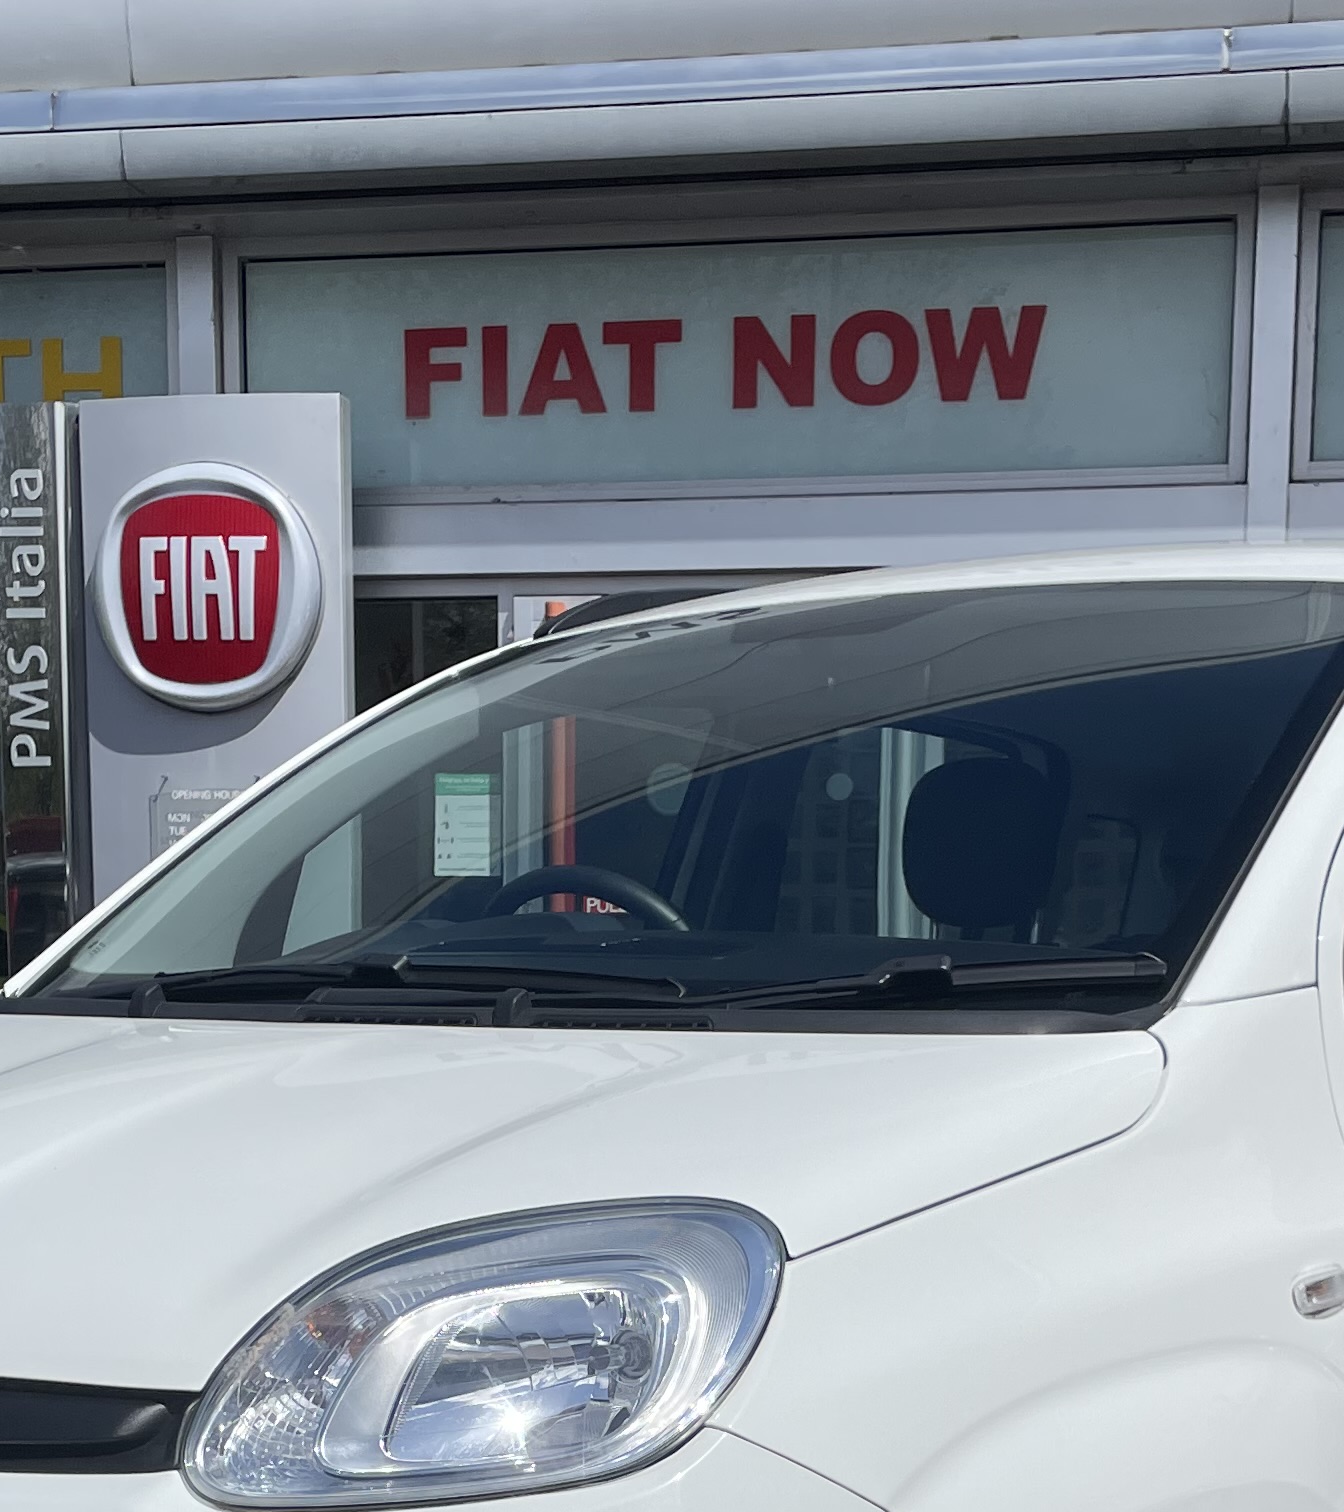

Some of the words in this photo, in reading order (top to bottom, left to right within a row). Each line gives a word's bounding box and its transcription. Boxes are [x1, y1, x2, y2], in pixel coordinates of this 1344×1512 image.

[402, 318, 683, 420] FIAT
[732, 305, 1048, 409] NOW
[138, 534, 268, 642] FIAT
[6, 644, 52, 768] PMS
[171, 789, 211, 800] OPENING
